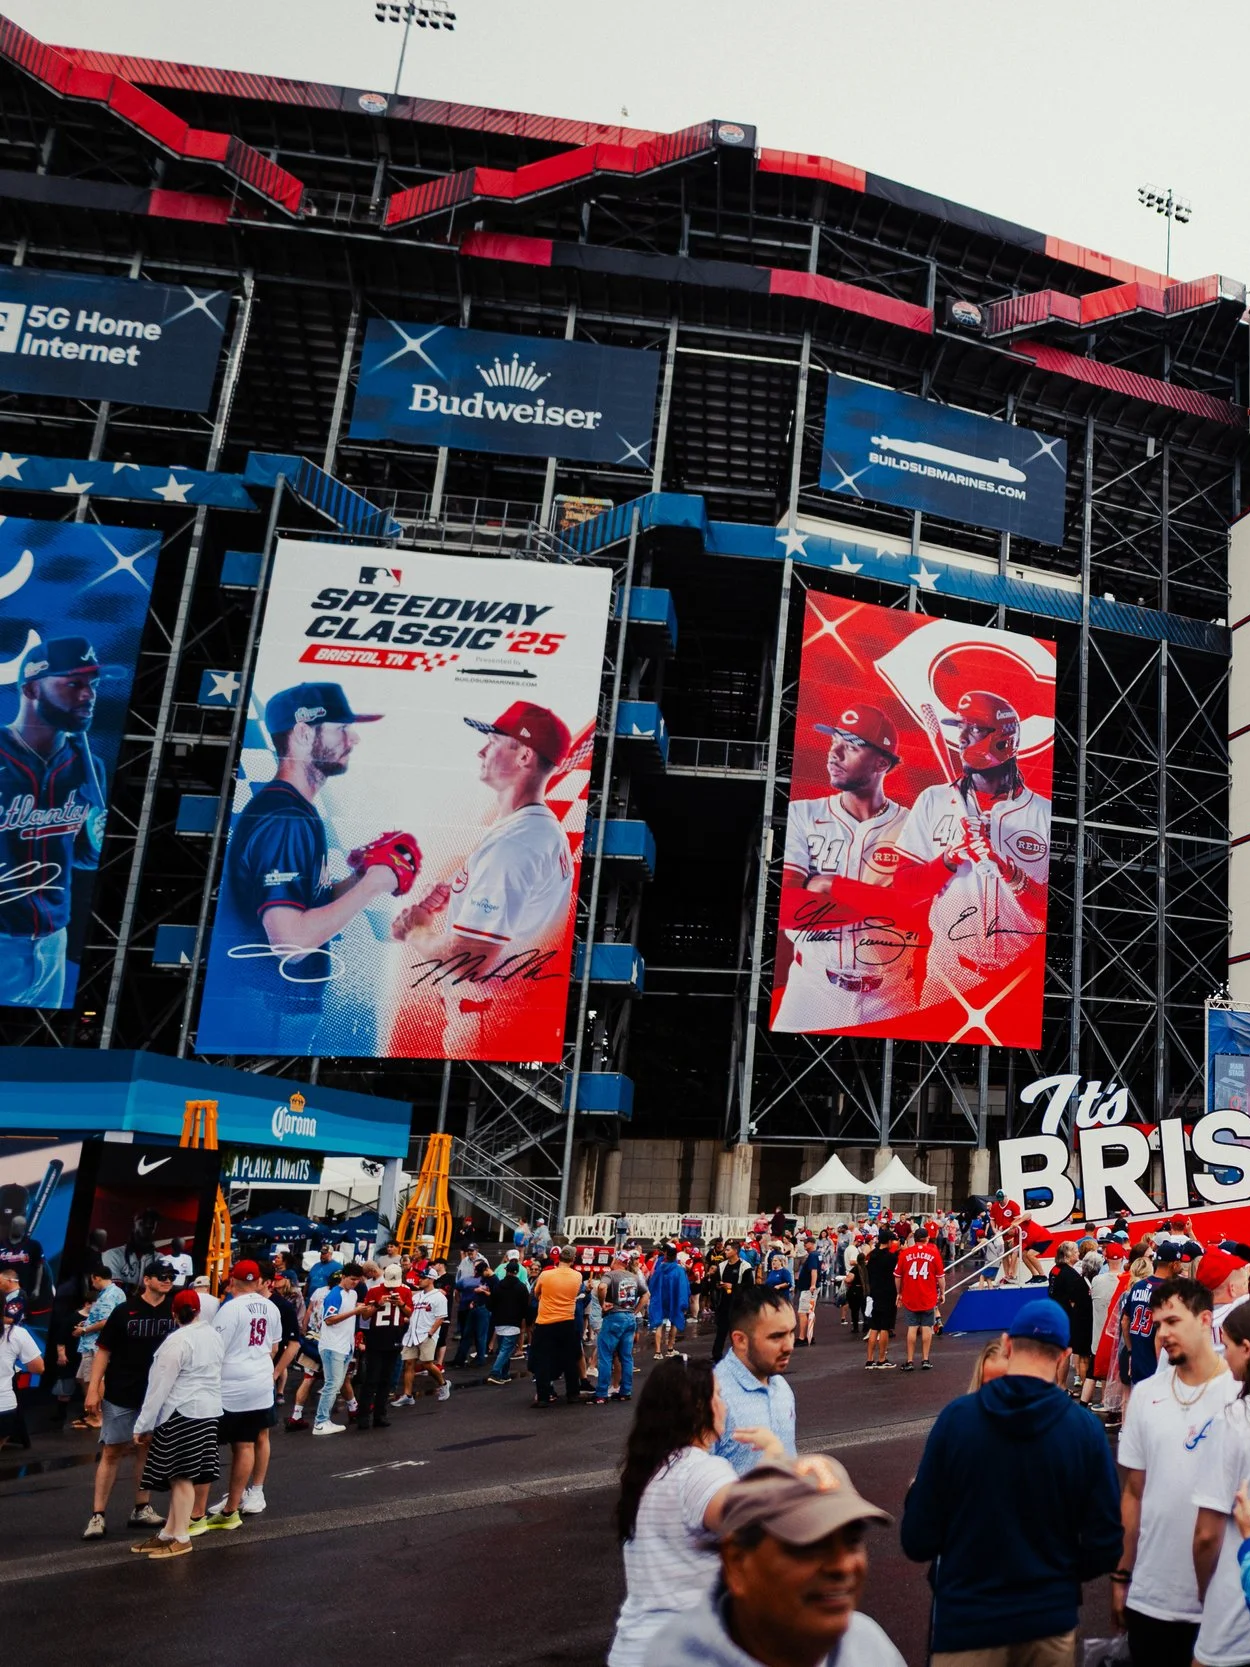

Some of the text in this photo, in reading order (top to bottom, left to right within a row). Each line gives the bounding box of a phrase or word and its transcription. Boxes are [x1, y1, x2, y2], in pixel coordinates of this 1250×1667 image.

[26, 304, 163, 341] 5G Home
[20, 332, 141, 367] Internet
[408, 382, 602, 430] Budweiser
[868, 452, 1026, 501] BUILDSUBMARINES.COM
[310, 587, 555, 626] SPEEDWAY
[304, 615, 503, 651] CLASSIC
[314, 648, 408, 666] BRISTOL, TN
[0, 788, 88, 832] tlanta
[873, 852, 900, 863] RED
[1017, 841, 1046, 853] REDS
[1020, 1074, 1129, 1135] It's
[271, 1105, 317, 1141] Corona
[274, 1157, 310, 1181] AWAITS
[908, 1260, 930, 1280] 44
[246, 1302, 268, 1315] VOTTO
[375, 1301, 401, 1327] 21
[1130, 1304, 1154, 1338] 13
[248, 1317, 268, 1347] 19
